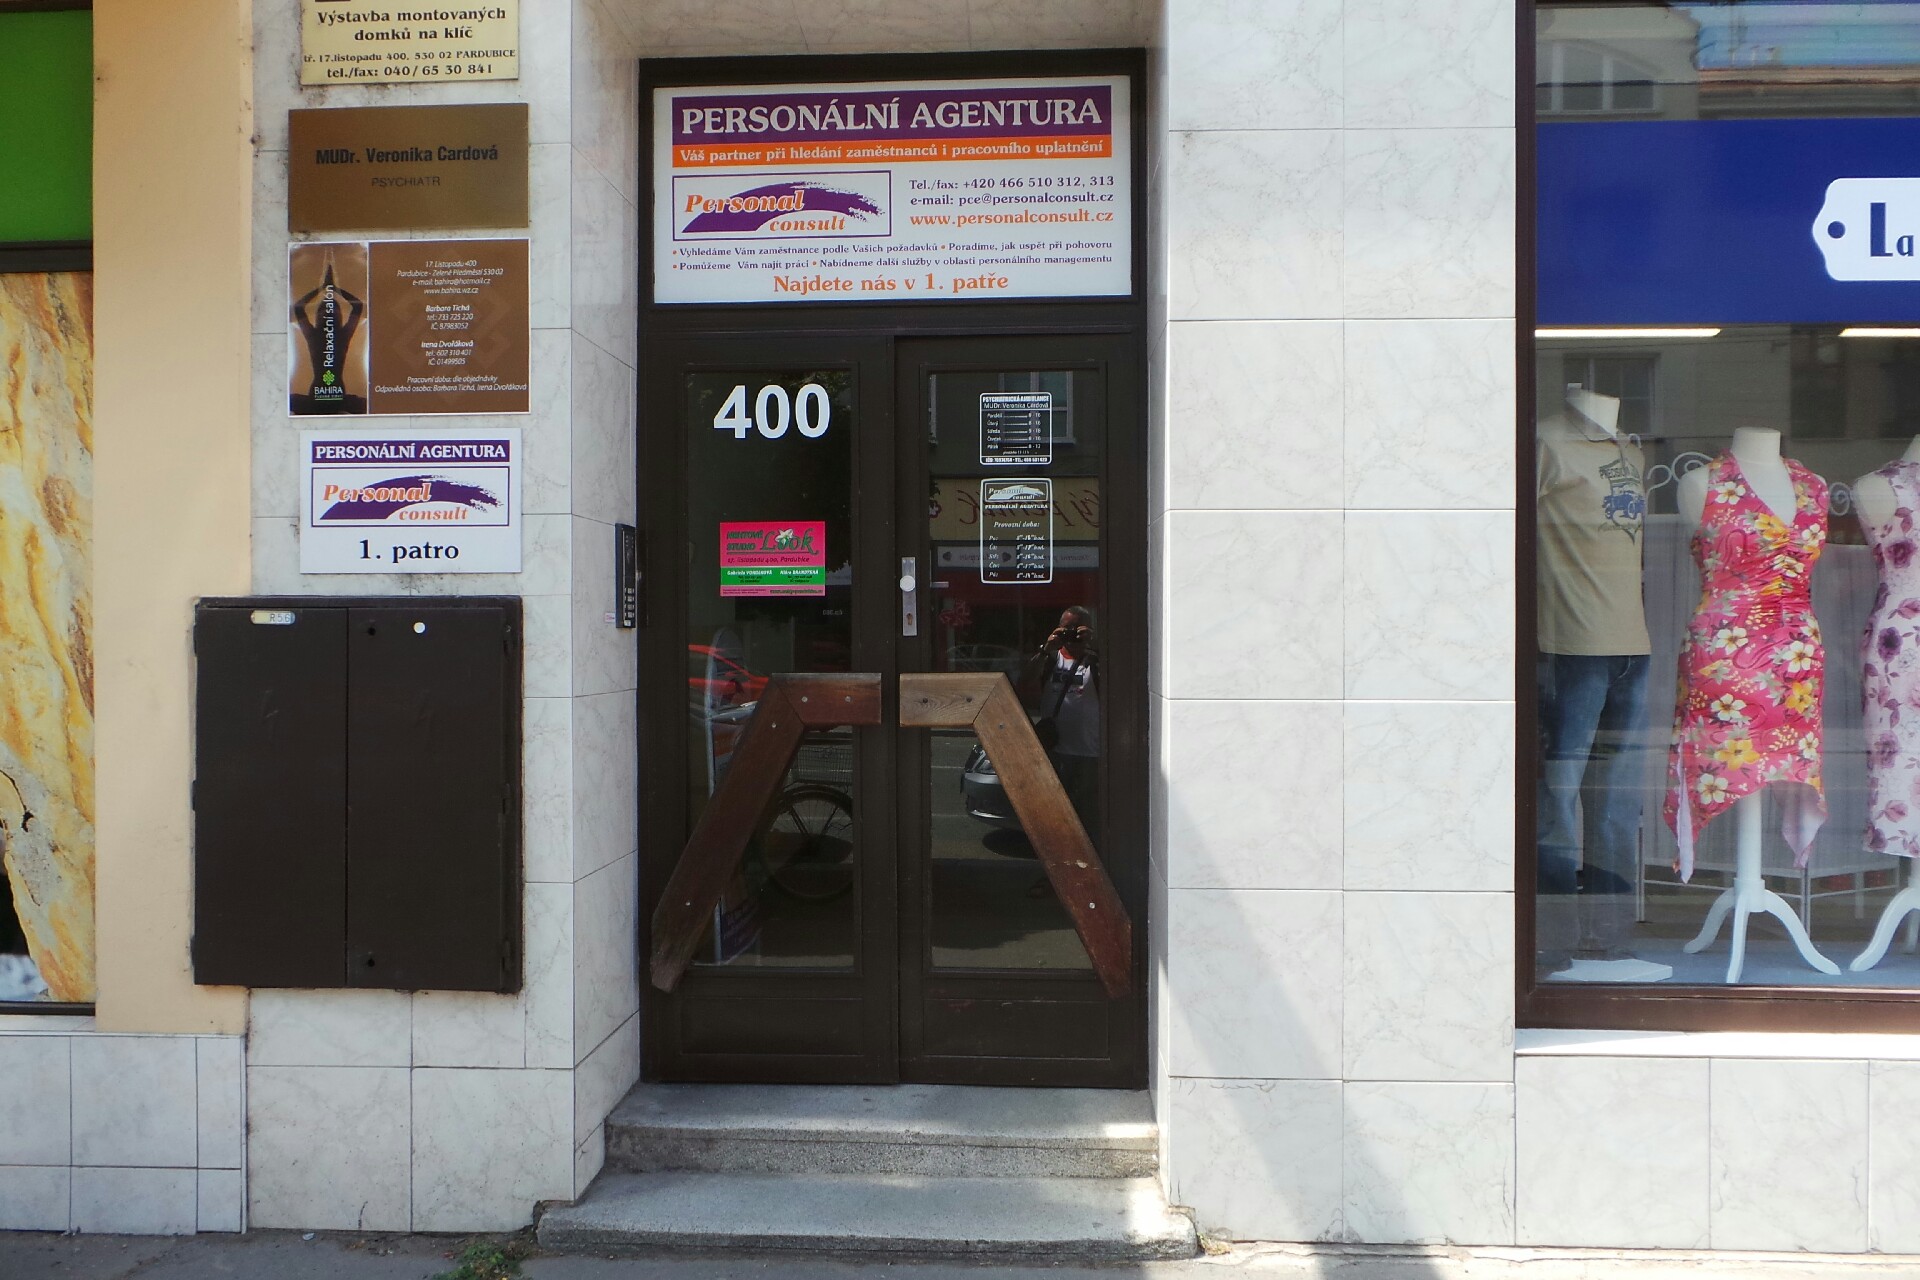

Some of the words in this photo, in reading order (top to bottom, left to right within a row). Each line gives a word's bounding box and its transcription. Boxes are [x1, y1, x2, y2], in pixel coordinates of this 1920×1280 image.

[317, 11, 390, 26] Výstavba
[397, 7, 506, 22] montovaných
[354, 27, 411, 41] domků
[419, 31, 438, 39] na
[444, 26, 473, 39] klíč
[414, 52, 435, 60] 530
[438, 51, 452, 60] 02
[456, 49, 516, 59] PARDUBICE
[327, 66, 379, 79] tel./fax:
[422, 66, 439, 76] 65
[445, 65, 462, 75] 30
[467, 64, 493, 74] 841
[682, 97, 899, 134] PERSONÁLNÍ
[910, 98, 1102, 128] AGENTURA
[316, 149, 361, 165] MUDr.
[366, 147, 433, 164] Veronika
[437, 144, 498, 162] Cardová
[680, 149, 705, 162] Váš
[709, 151, 762, 163] partner
[766, 148, 786, 162] při
[790, 147, 842, 159] hledání
[846, 144, 937, 159] zaměstnanců
[942, 144, 947, 155] i
[952, 142, 1031, 158] pracovního
[1036, 140, 1103, 154] uplatnění
[371, 177, 441, 188] PSYCHIATR
[909, 179, 959, 191] Tel./fax:
[963, 178, 995, 189] +420
[999, 177, 1024, 188] 466
[1028, 177, 1052, 188] 510
[1057, 176, 1085, 188] 312,
[1090, 176, 1114, 186] 313
[684, 190, 805, 214] Personal
[910, 195, 954, 206] e-mail:
[958, 191, 1114, 207] pce@personalconsult.cz
[769, 216, 846, 232] consult
[910, 208, 1114, 227] www.personalconsult.cz
[1870, 202, 1914, 258] La
[679, 247, 732, 258] Vyhledáme
[735, 246, 756, 256] Vám
[758, 246, 819, 255] zaměstnance
[822, 245, 849, 255] podle
[852, 244, 883, 253] Vašich
[886, 243, 938, 254] požadavků
[949, 242, 998, 252] Poradíme,
[1000, 242, 1016, 252] jak
[1019, 242, 1045, 252] uspět
[1049, 241, 1062, 251] při
[1065, 241, 1112, 251] pohovoru
[679, 261, 731, 270] Pomůžeme
[737, 261, 758, 269] Vám
[761, 260, 782, 271] najít
[785, 260, 809, 270] práci
[819, 258, 873, 267] Nabídneme
[876, 257, 899, 266] další
[901, 257, 931, 267] služby
[943, 257, 975, 265] oblasti
[978, 256, 1041, 266] personálního
[1044, 255, 1112, 266] managementu
[773, 275, 853, 295] Najdete
[860, 275, 896, 291] nás
[904, 279, 916, 290] v
[925, 274, 944, 290] 1.
[952, 272, 1009, 293] patře
[452, 304, 470, 312] Tichá
[323, 316, 334, 367] Relaxační
[421, 340, 438, 348] Irena
[315, 386, 343, 395] BAHIRA
[713, 383, 830, 439] 400
[315, 443, 415, 459] PERSONÁLNÍ
[419, 445, 506, 458] AGENTURA
[323, 483, 432, 502] Personal
[399, 507, 468, 520] consult
[360, 540, 381, 559] 1.
[392, 541, 459, 563] patro
